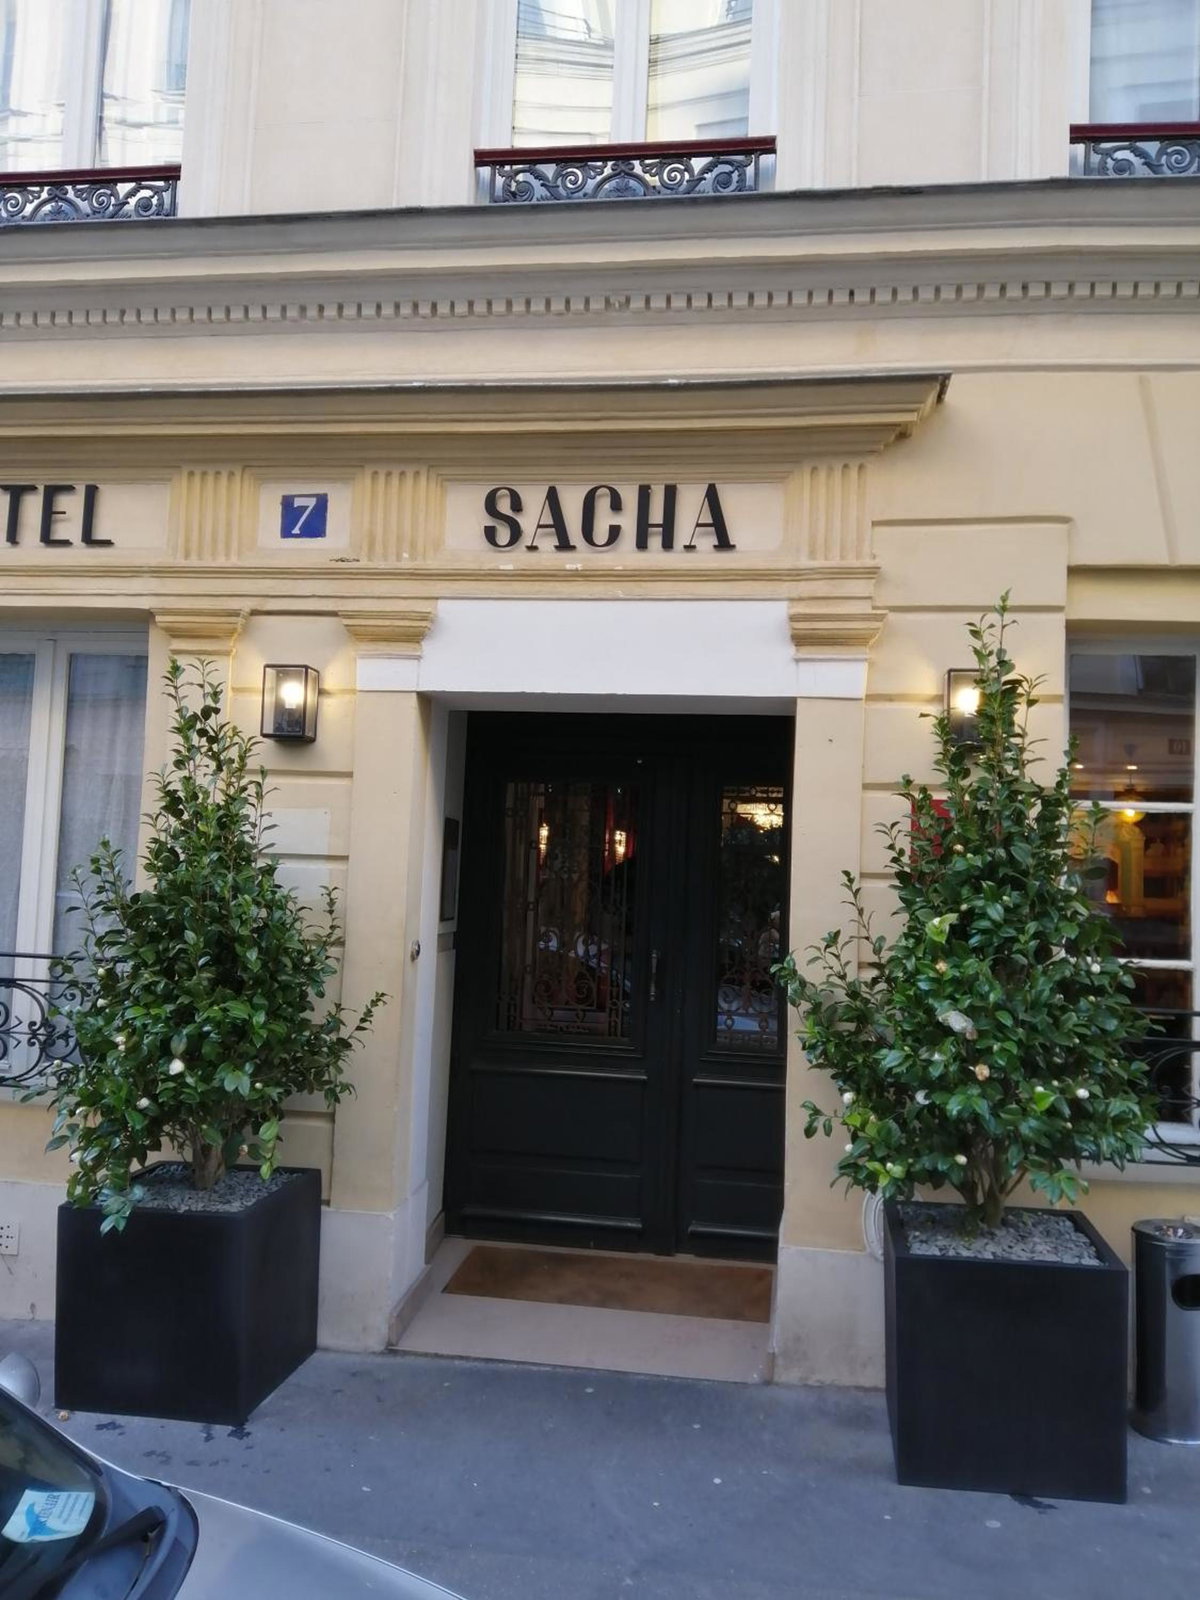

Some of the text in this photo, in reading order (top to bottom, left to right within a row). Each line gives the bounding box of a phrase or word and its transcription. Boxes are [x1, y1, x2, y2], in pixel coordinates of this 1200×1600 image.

[0, 484, 115, 545] TEL
[291, 497, 317, 534] 7
[484, 483, 737, 551] SACHA
